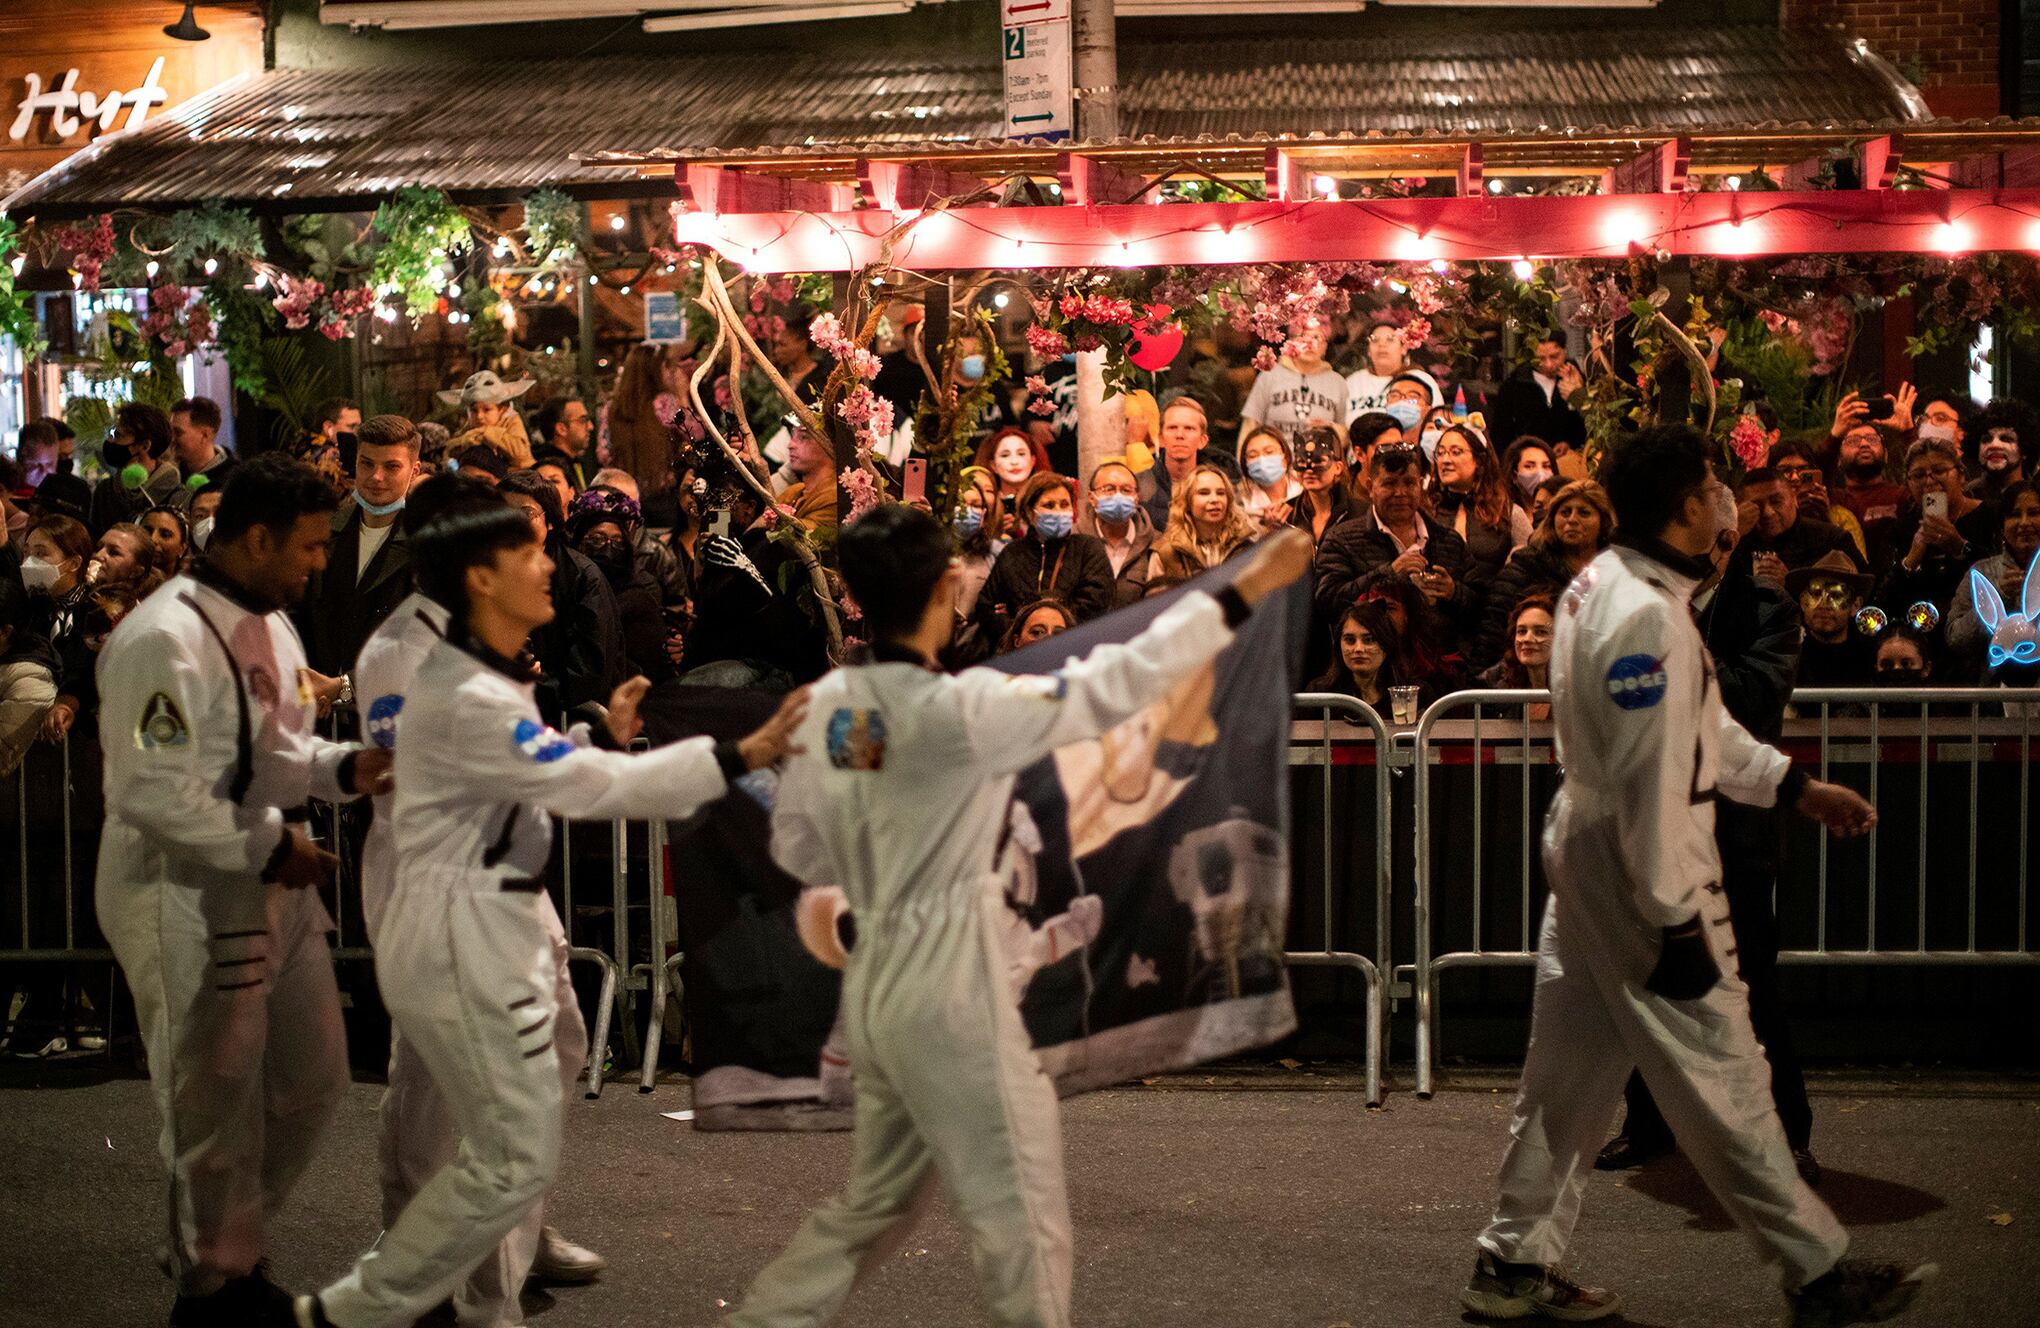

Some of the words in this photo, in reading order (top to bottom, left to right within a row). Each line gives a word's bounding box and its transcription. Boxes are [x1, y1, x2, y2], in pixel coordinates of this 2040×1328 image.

[1009, 29, 1021, 57] 2
[1026, 37, 1049, 47] metered
[9, 56, 168, 139] Hut
[1009, 92, 1030, 103] Except
[1031, 89, 1053, 101] Sunday
[1272, 389, 1337, 411] HARVARD
[1351, 394, 1387, 410] YAL
